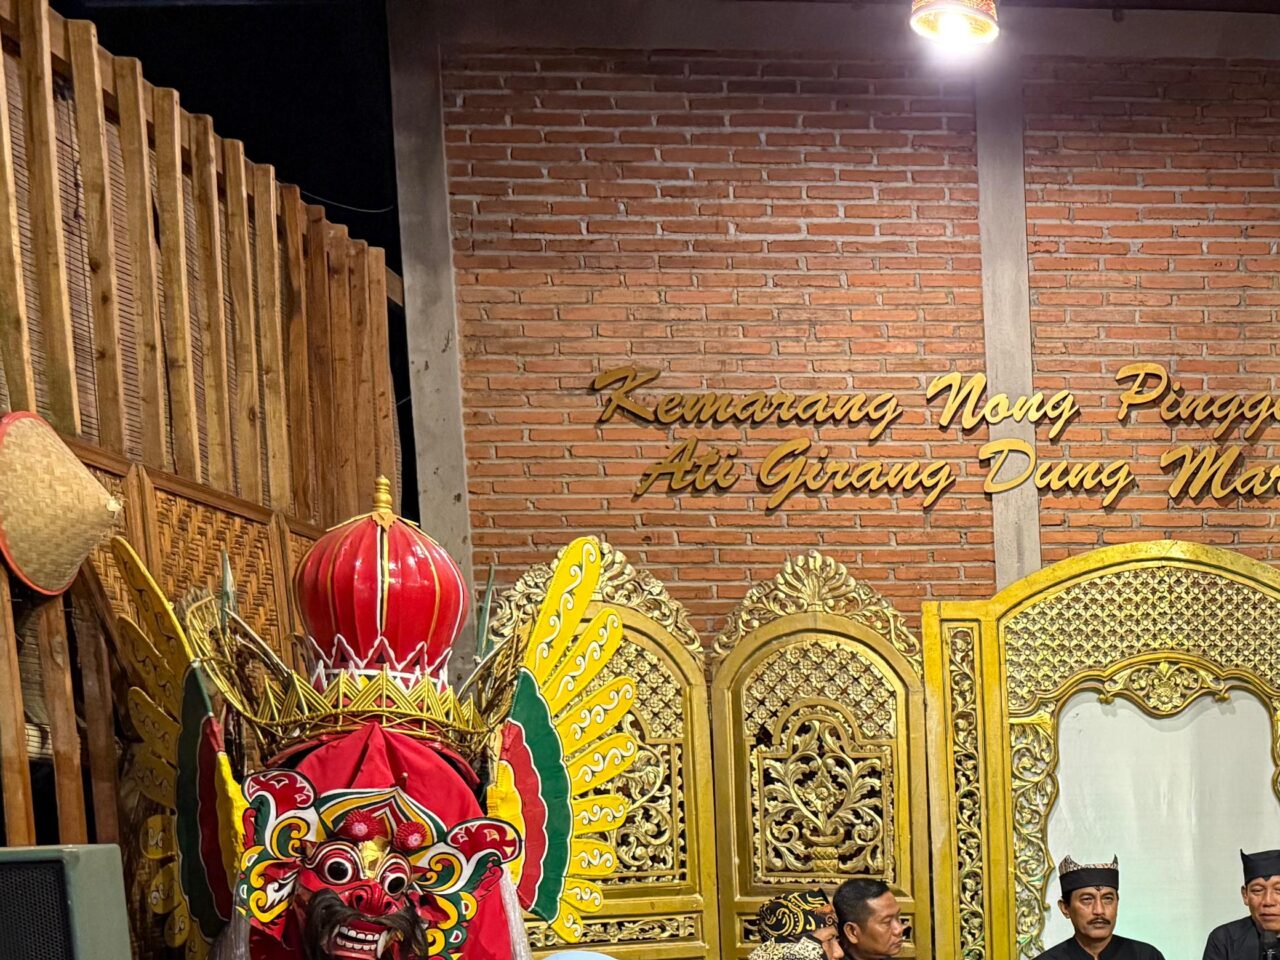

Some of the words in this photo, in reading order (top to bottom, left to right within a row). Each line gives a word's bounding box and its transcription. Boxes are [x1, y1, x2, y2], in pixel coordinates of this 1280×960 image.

[592, 365, 903, 439] Kemarang
[926, 371, 1079, 438] Nong
[634, 435, 737, 497] Ati
[759, 437, 956, 509] Girang
[978, 438, 1135, 507] Dung
